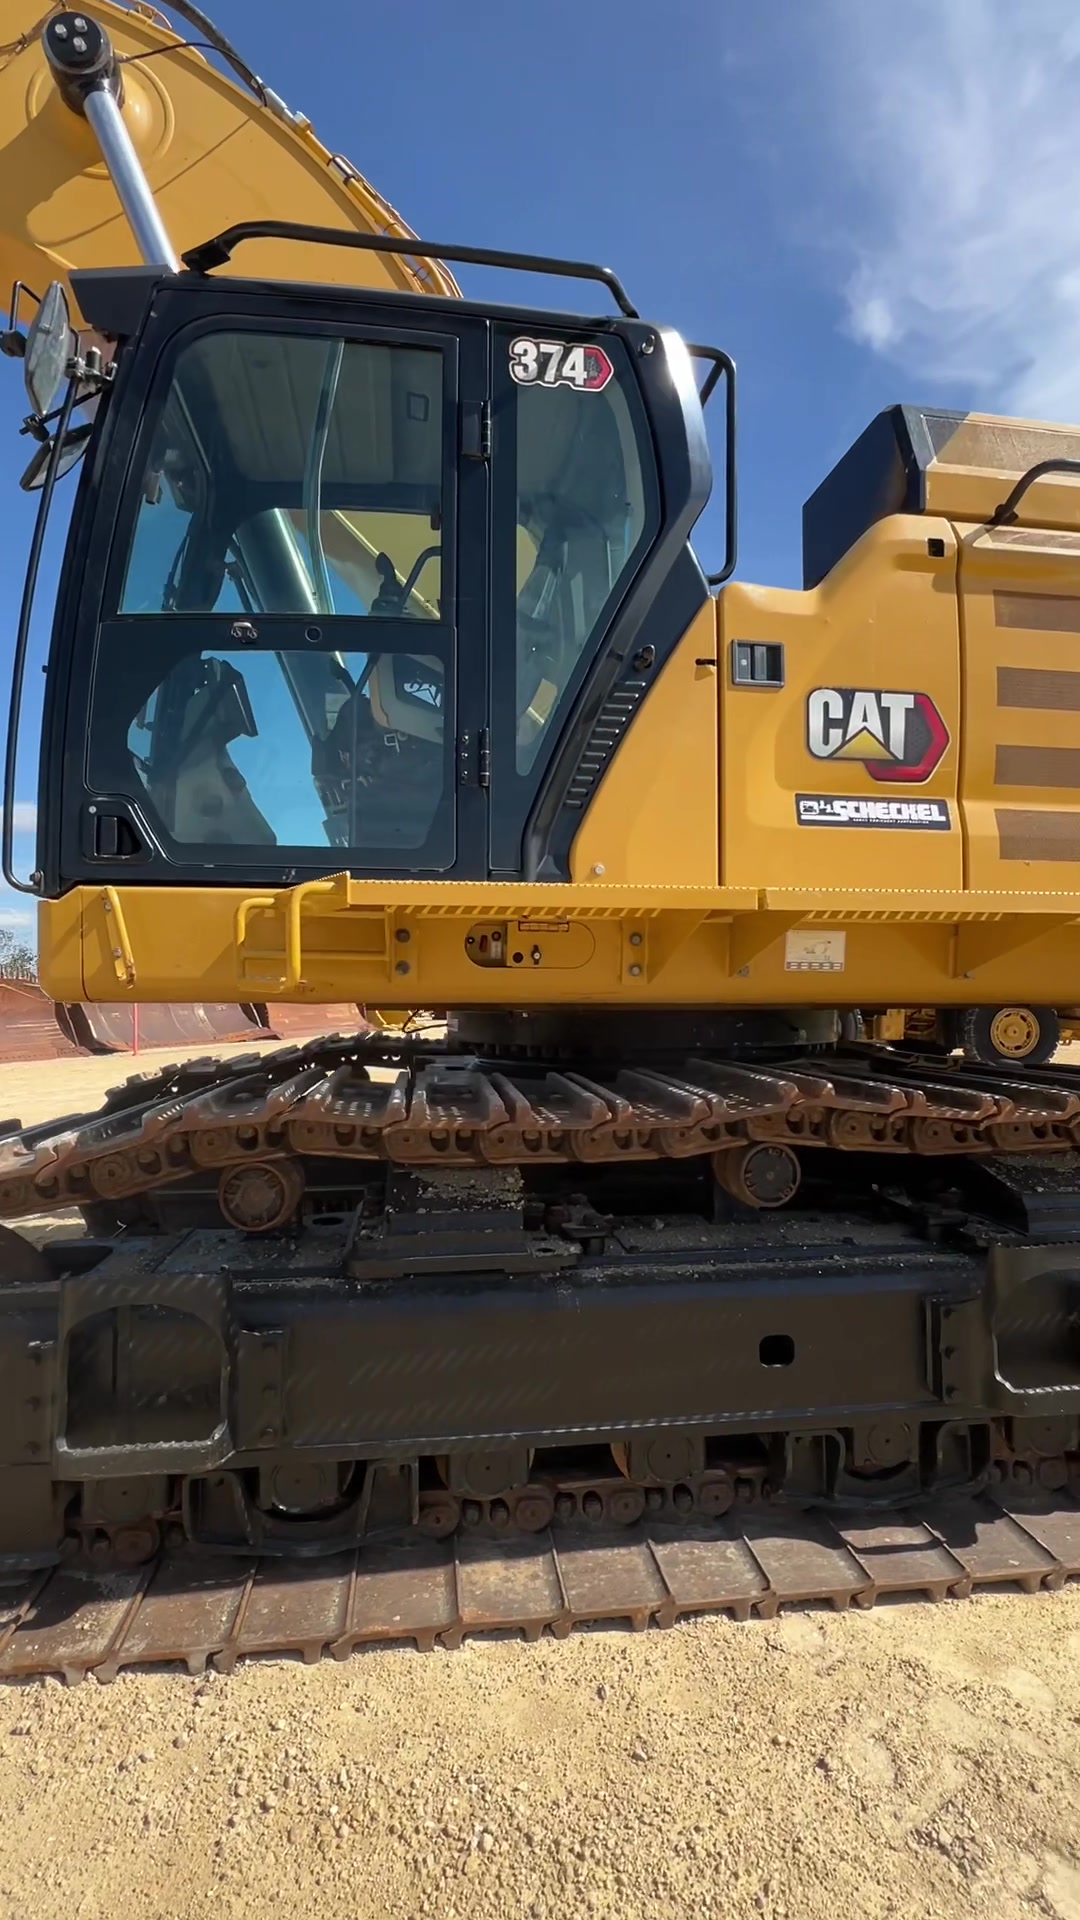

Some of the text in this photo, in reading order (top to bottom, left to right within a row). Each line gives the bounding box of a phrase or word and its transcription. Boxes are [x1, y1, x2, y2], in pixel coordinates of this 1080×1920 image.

[513, 341, 588, 385] 374
[809, 689, 915, 760] CAT
[833, 800, 946, 821] SCHECKEL
